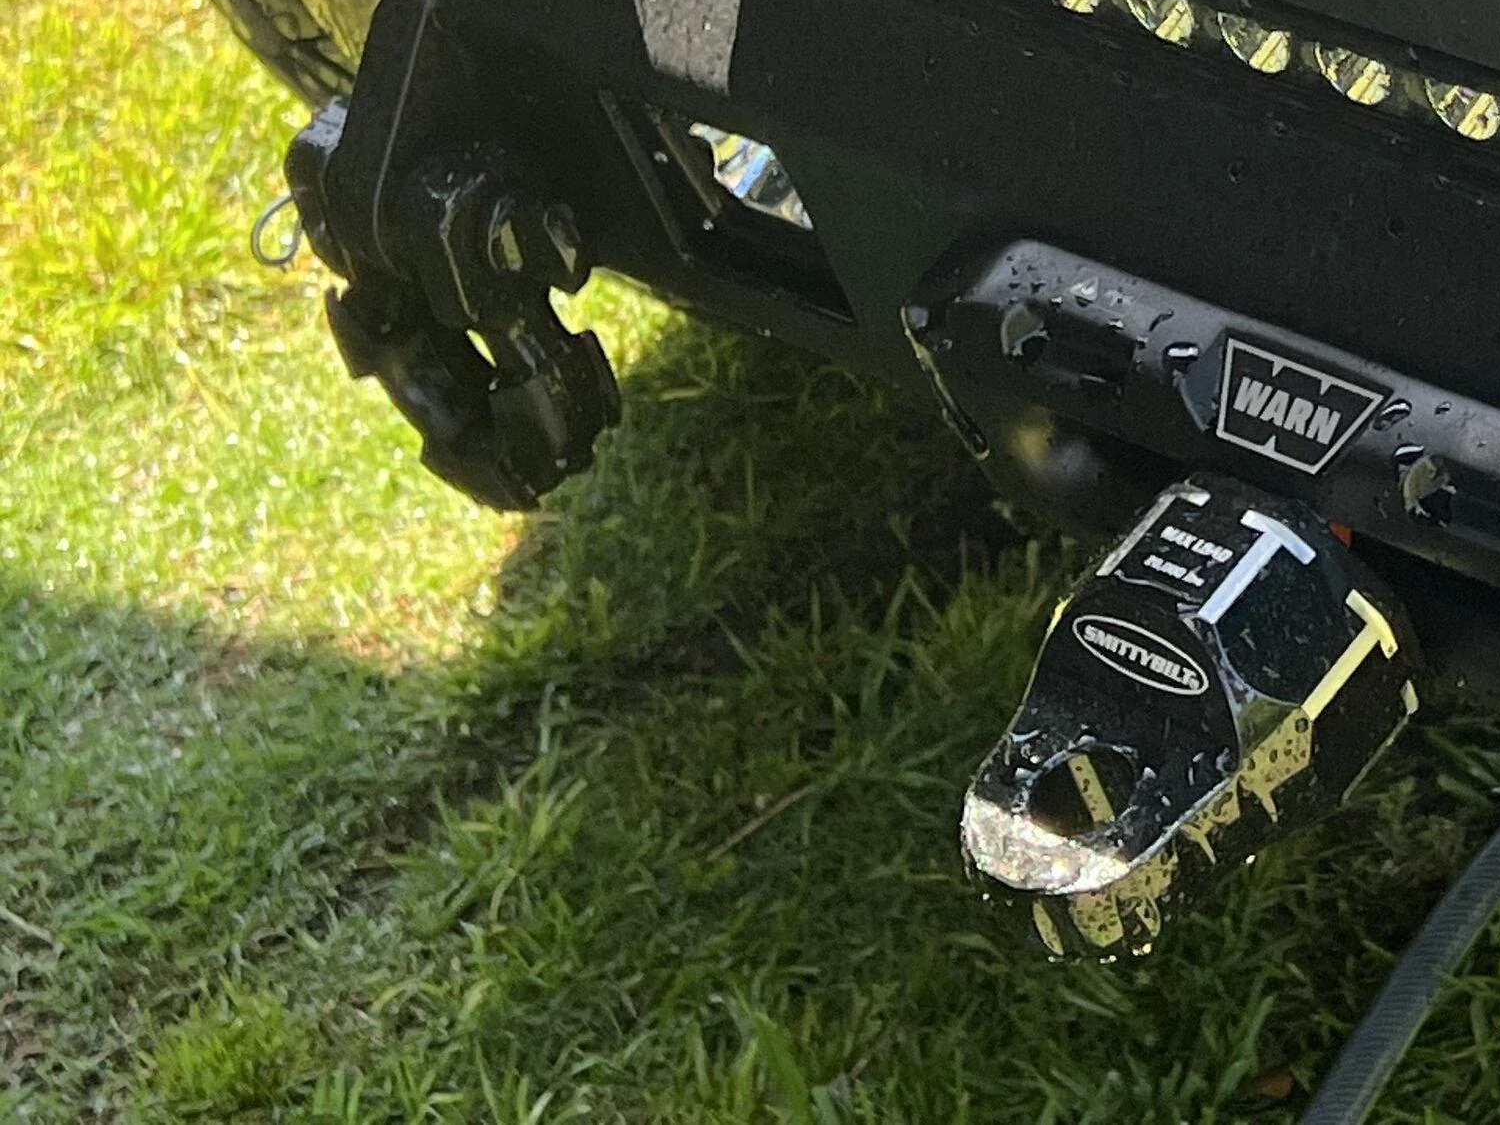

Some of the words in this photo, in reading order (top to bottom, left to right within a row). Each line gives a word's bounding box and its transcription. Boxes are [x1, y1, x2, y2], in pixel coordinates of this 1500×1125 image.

[1232, 376, 1342, 445] WARN
[1160, 525, 1198, 549] MAX
[1191, 538, 1233, 563] LOAD
[1084, 624, 1197, 688] SMITTYBILT
